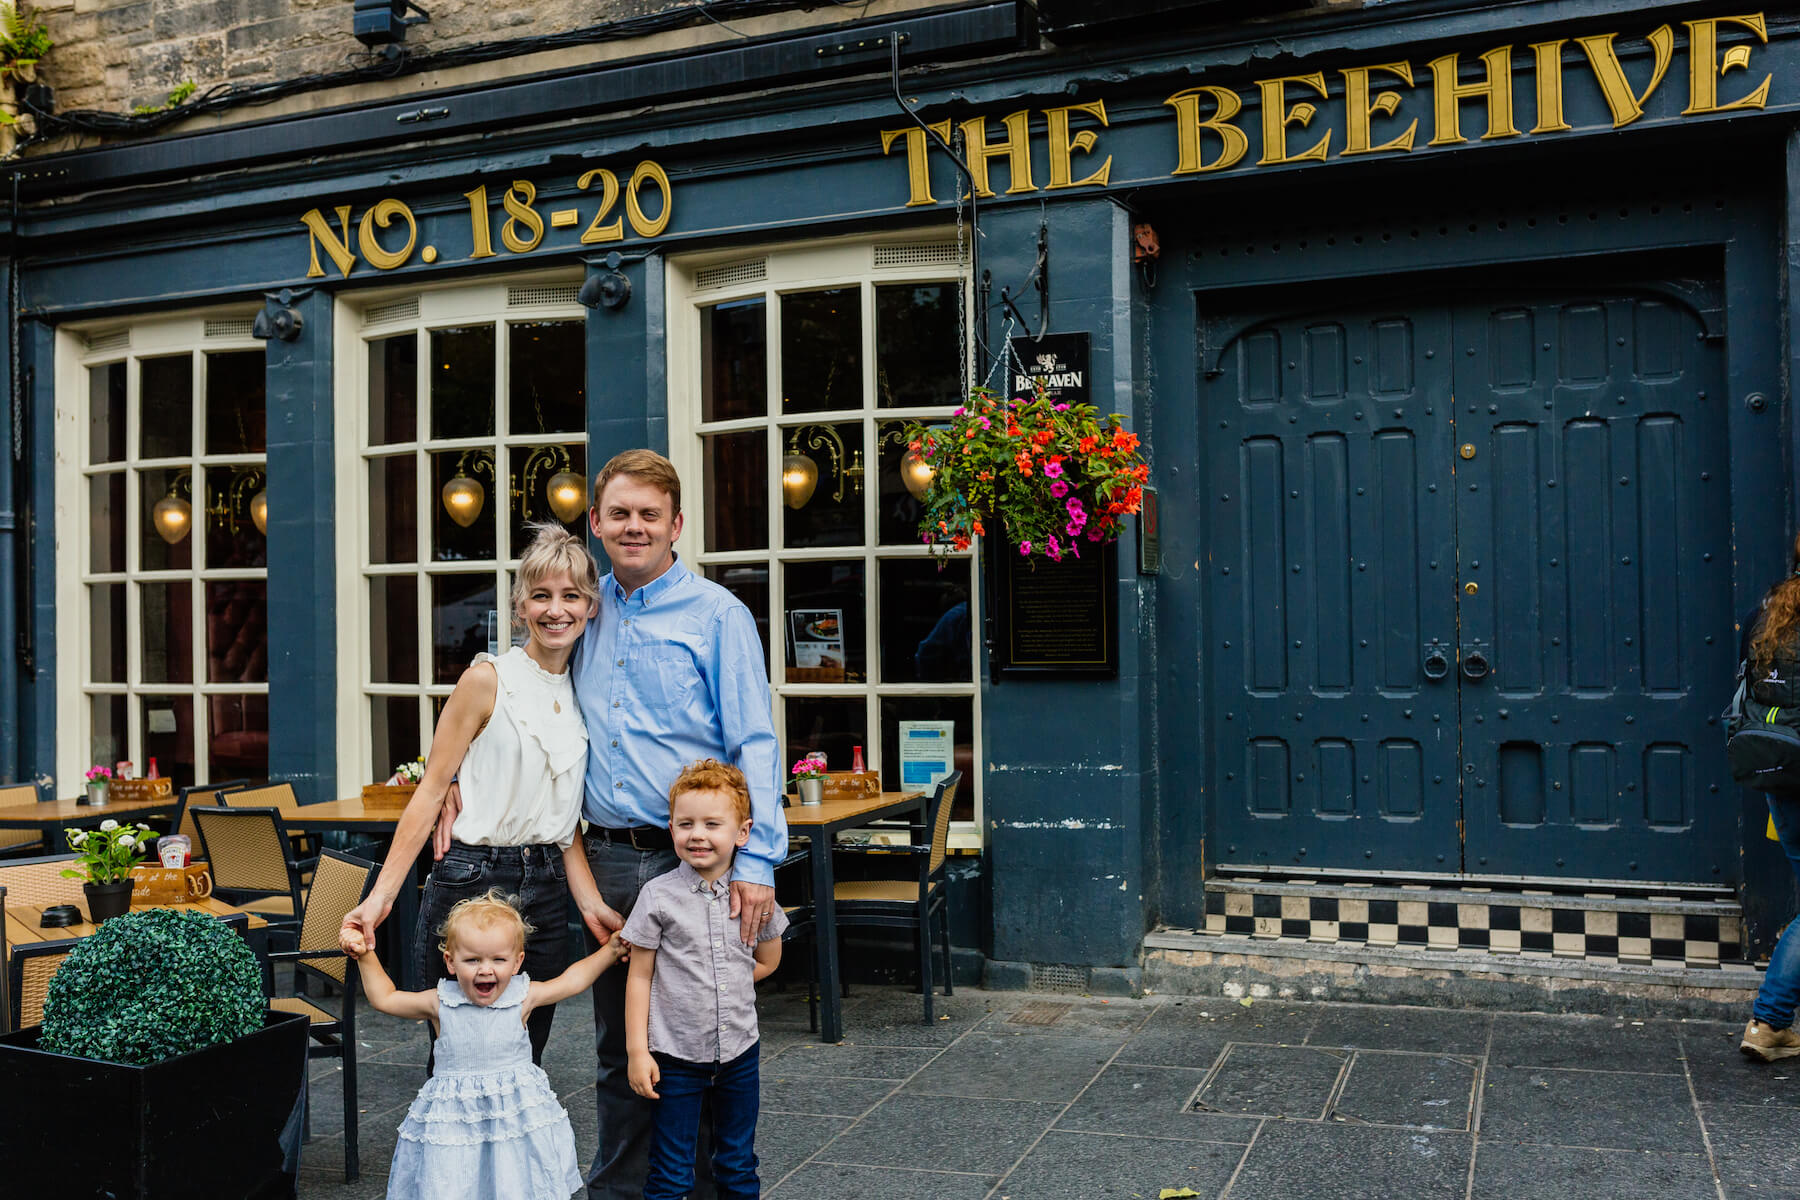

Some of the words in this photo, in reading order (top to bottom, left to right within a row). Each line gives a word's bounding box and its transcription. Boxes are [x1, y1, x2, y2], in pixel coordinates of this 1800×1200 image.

[880, 98, 1112, 207] THE
[1163, 11, 1773, 176] BEEHIVE
[300, 198, 437, 279] NO.
[463, 159, 672, 259] 18-20
[1015, 371, 1082, 392] BEAVEN
[164, 871, 178, 881] the
